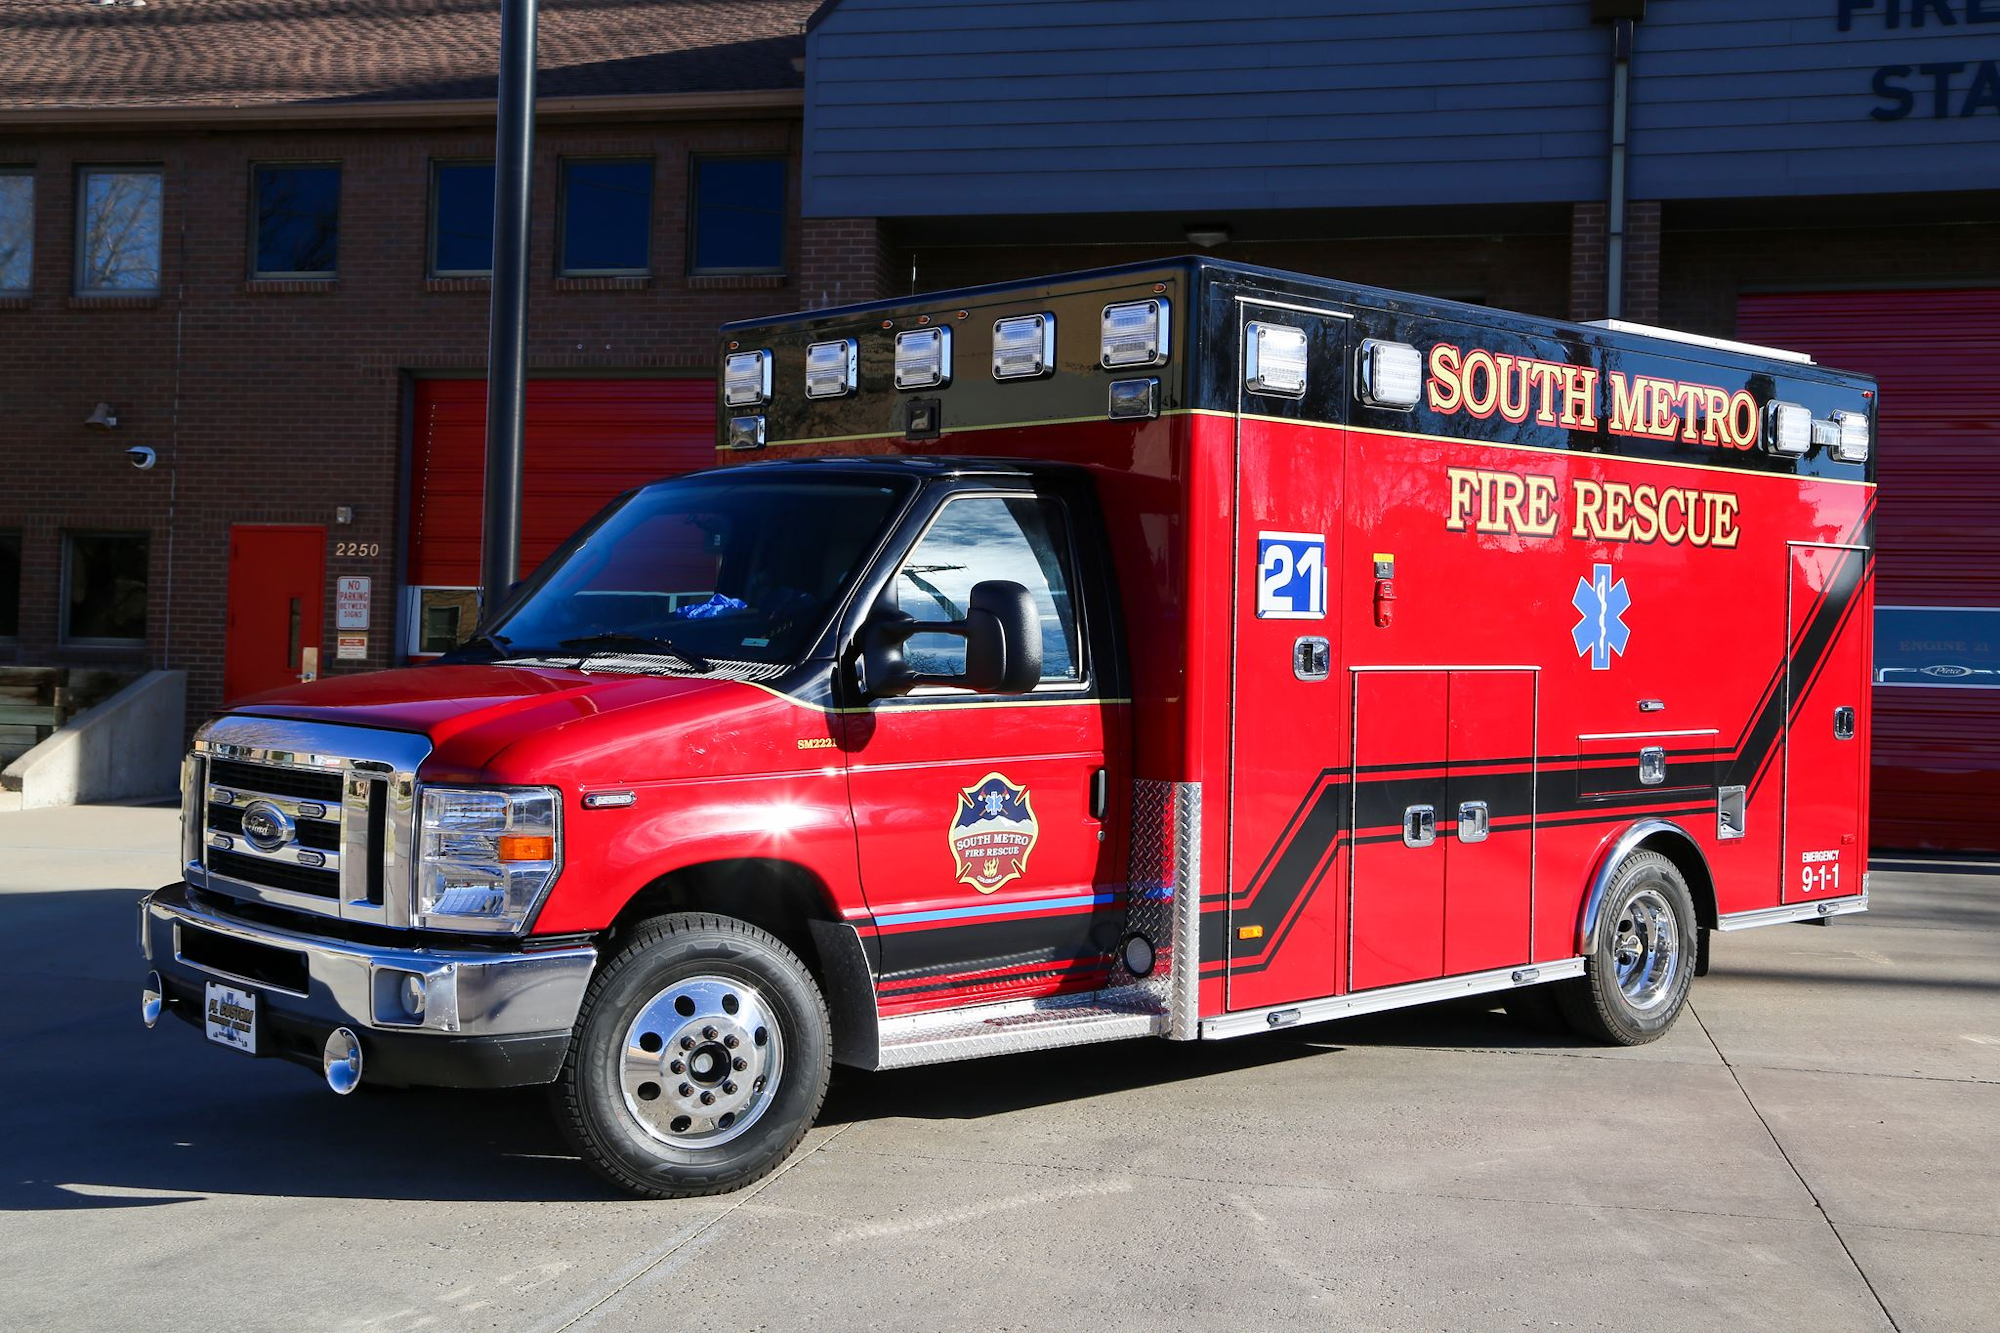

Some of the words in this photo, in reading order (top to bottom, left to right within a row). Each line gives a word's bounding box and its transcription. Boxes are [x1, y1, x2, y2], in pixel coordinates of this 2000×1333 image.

[1870, 60, 2000, 121] STA
[1428, 342, 1598, 432] SOUTH
[1608, 370, 1759, 450] METRO
[1446, 465, 1559, 537] FIRE
[1571, 478, 1740, 549] RESCUE
[335, 543, 379, 557] 2250
[347, 580, 360, 590] NO
[1264, 544, 1322, 612] 21
[340, 591, 368, 601] PARKING
[339, 602, 367, 610] BETWEEN
[1899, 640, 1967, 652] ENGINE
[1973, 642, 1990, 652] 21
[797, 737, 837, 750] SM2221
[956, 835, 991, 851] SOUTH
[993, 833, 1029, 846] METRO
[964, 848, 985, 858] FIRE
[986, 846, 1019, 857] RESCUE
[1802, 849, 1840, 863] EMERGENCY
[976, 874, 1003, 884] COLORADO
[1802, 863, 1840, 892] 9-1-1
[219, 1002, 254, 1024] CUSTOM
